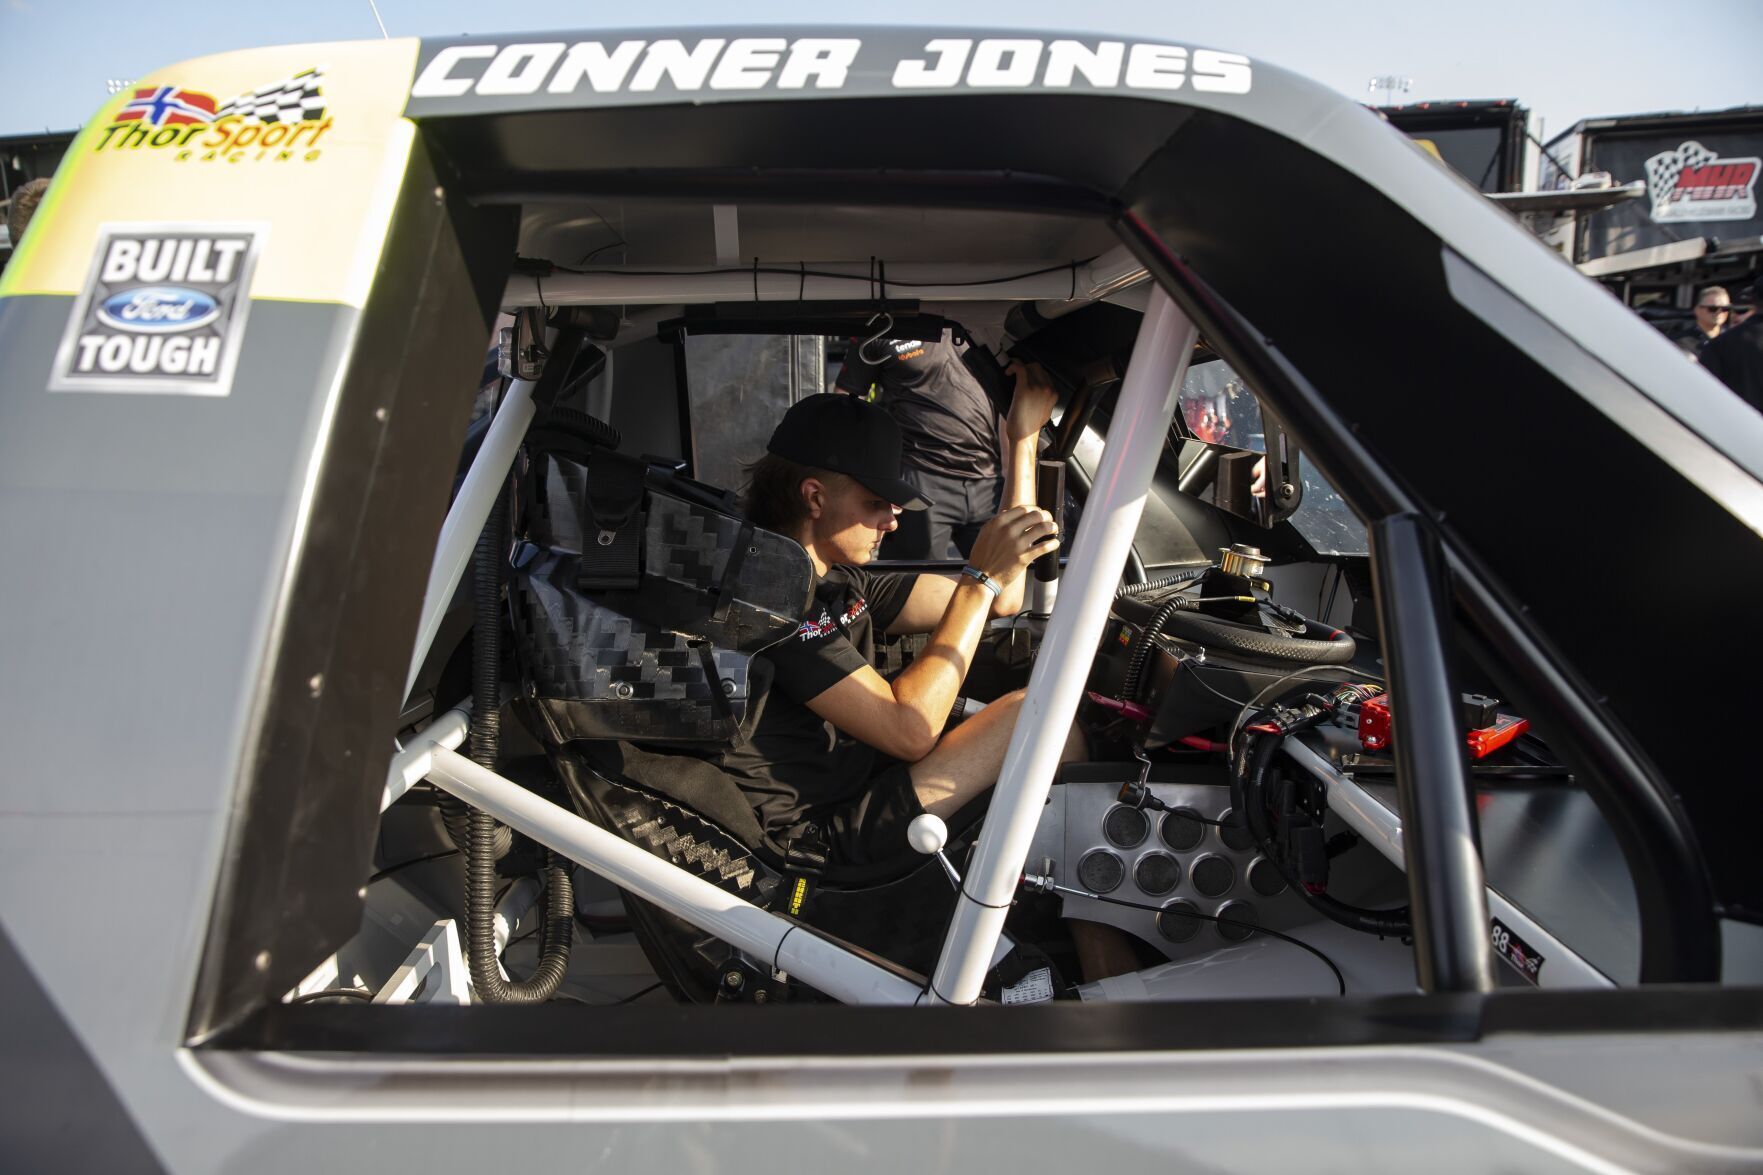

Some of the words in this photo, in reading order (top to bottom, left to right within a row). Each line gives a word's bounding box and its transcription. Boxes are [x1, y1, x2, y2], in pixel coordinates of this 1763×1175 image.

[412, 38, 861, 97] CONNER
[892, 38, 1254, 94] JONES
[175, 150, 322, 163] RACING
[101, 239, 247, 282] BUILT
[121, 292, 194, 321] Ford
[79, 335, 221, 374] TOUGH
[1491, 925, 1510, 953] 88
